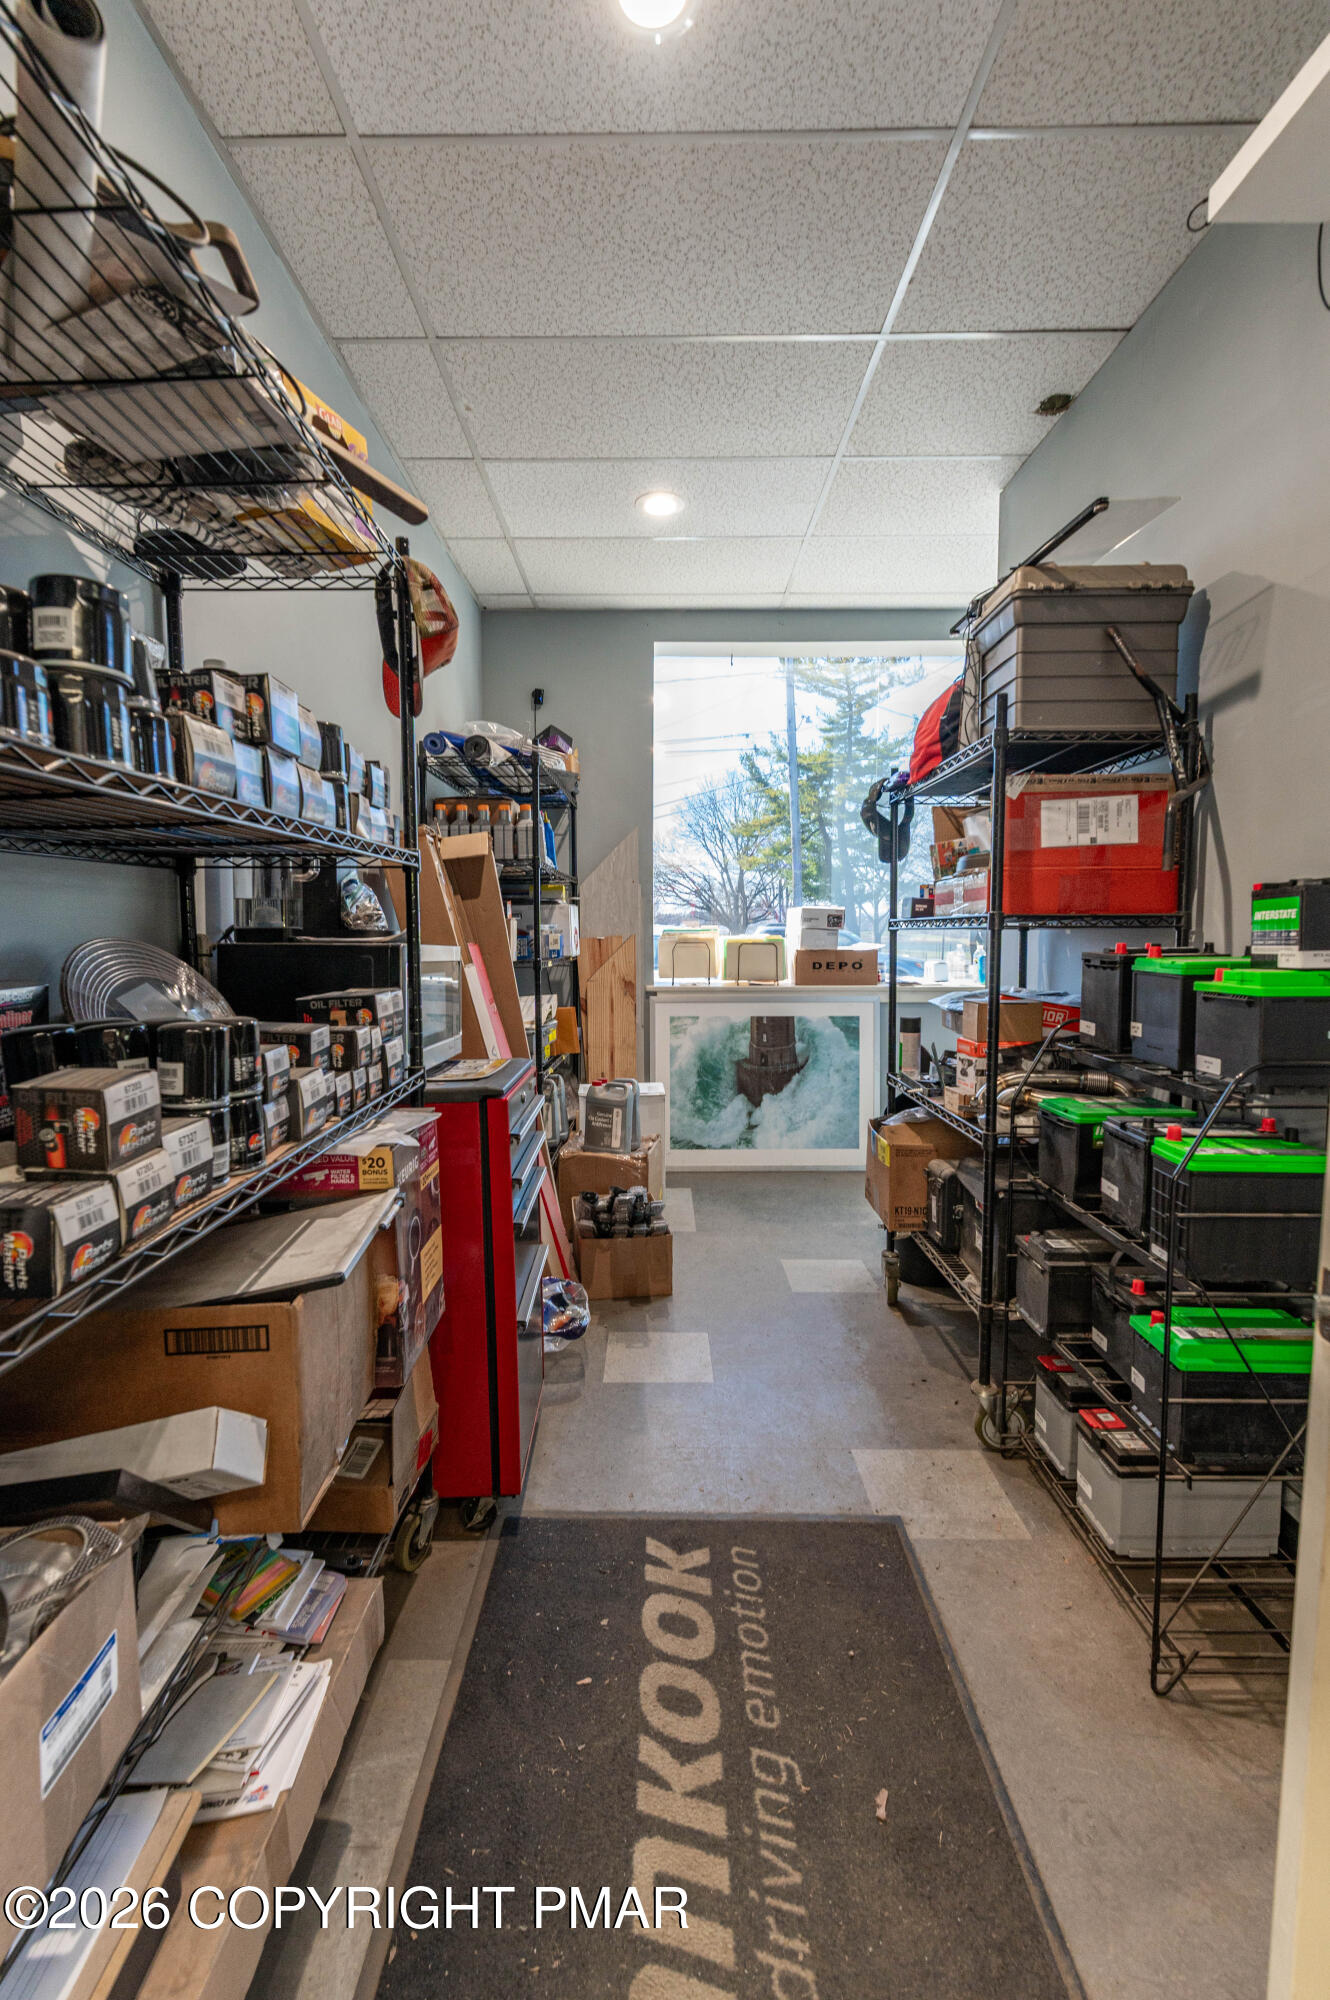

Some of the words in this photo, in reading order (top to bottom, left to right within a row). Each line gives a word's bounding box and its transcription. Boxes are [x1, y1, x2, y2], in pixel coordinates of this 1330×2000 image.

[1253, 908, 1298, 920] INTERSTATE
[812, 961, 863, 970] DEPO
[310, 1000, 327, 1009] OIL
[329, 999, 362, 1008] FILTER
[330, 1155, 355, 1163] VALUE
[724, 1545, 781, 1729] emotion
